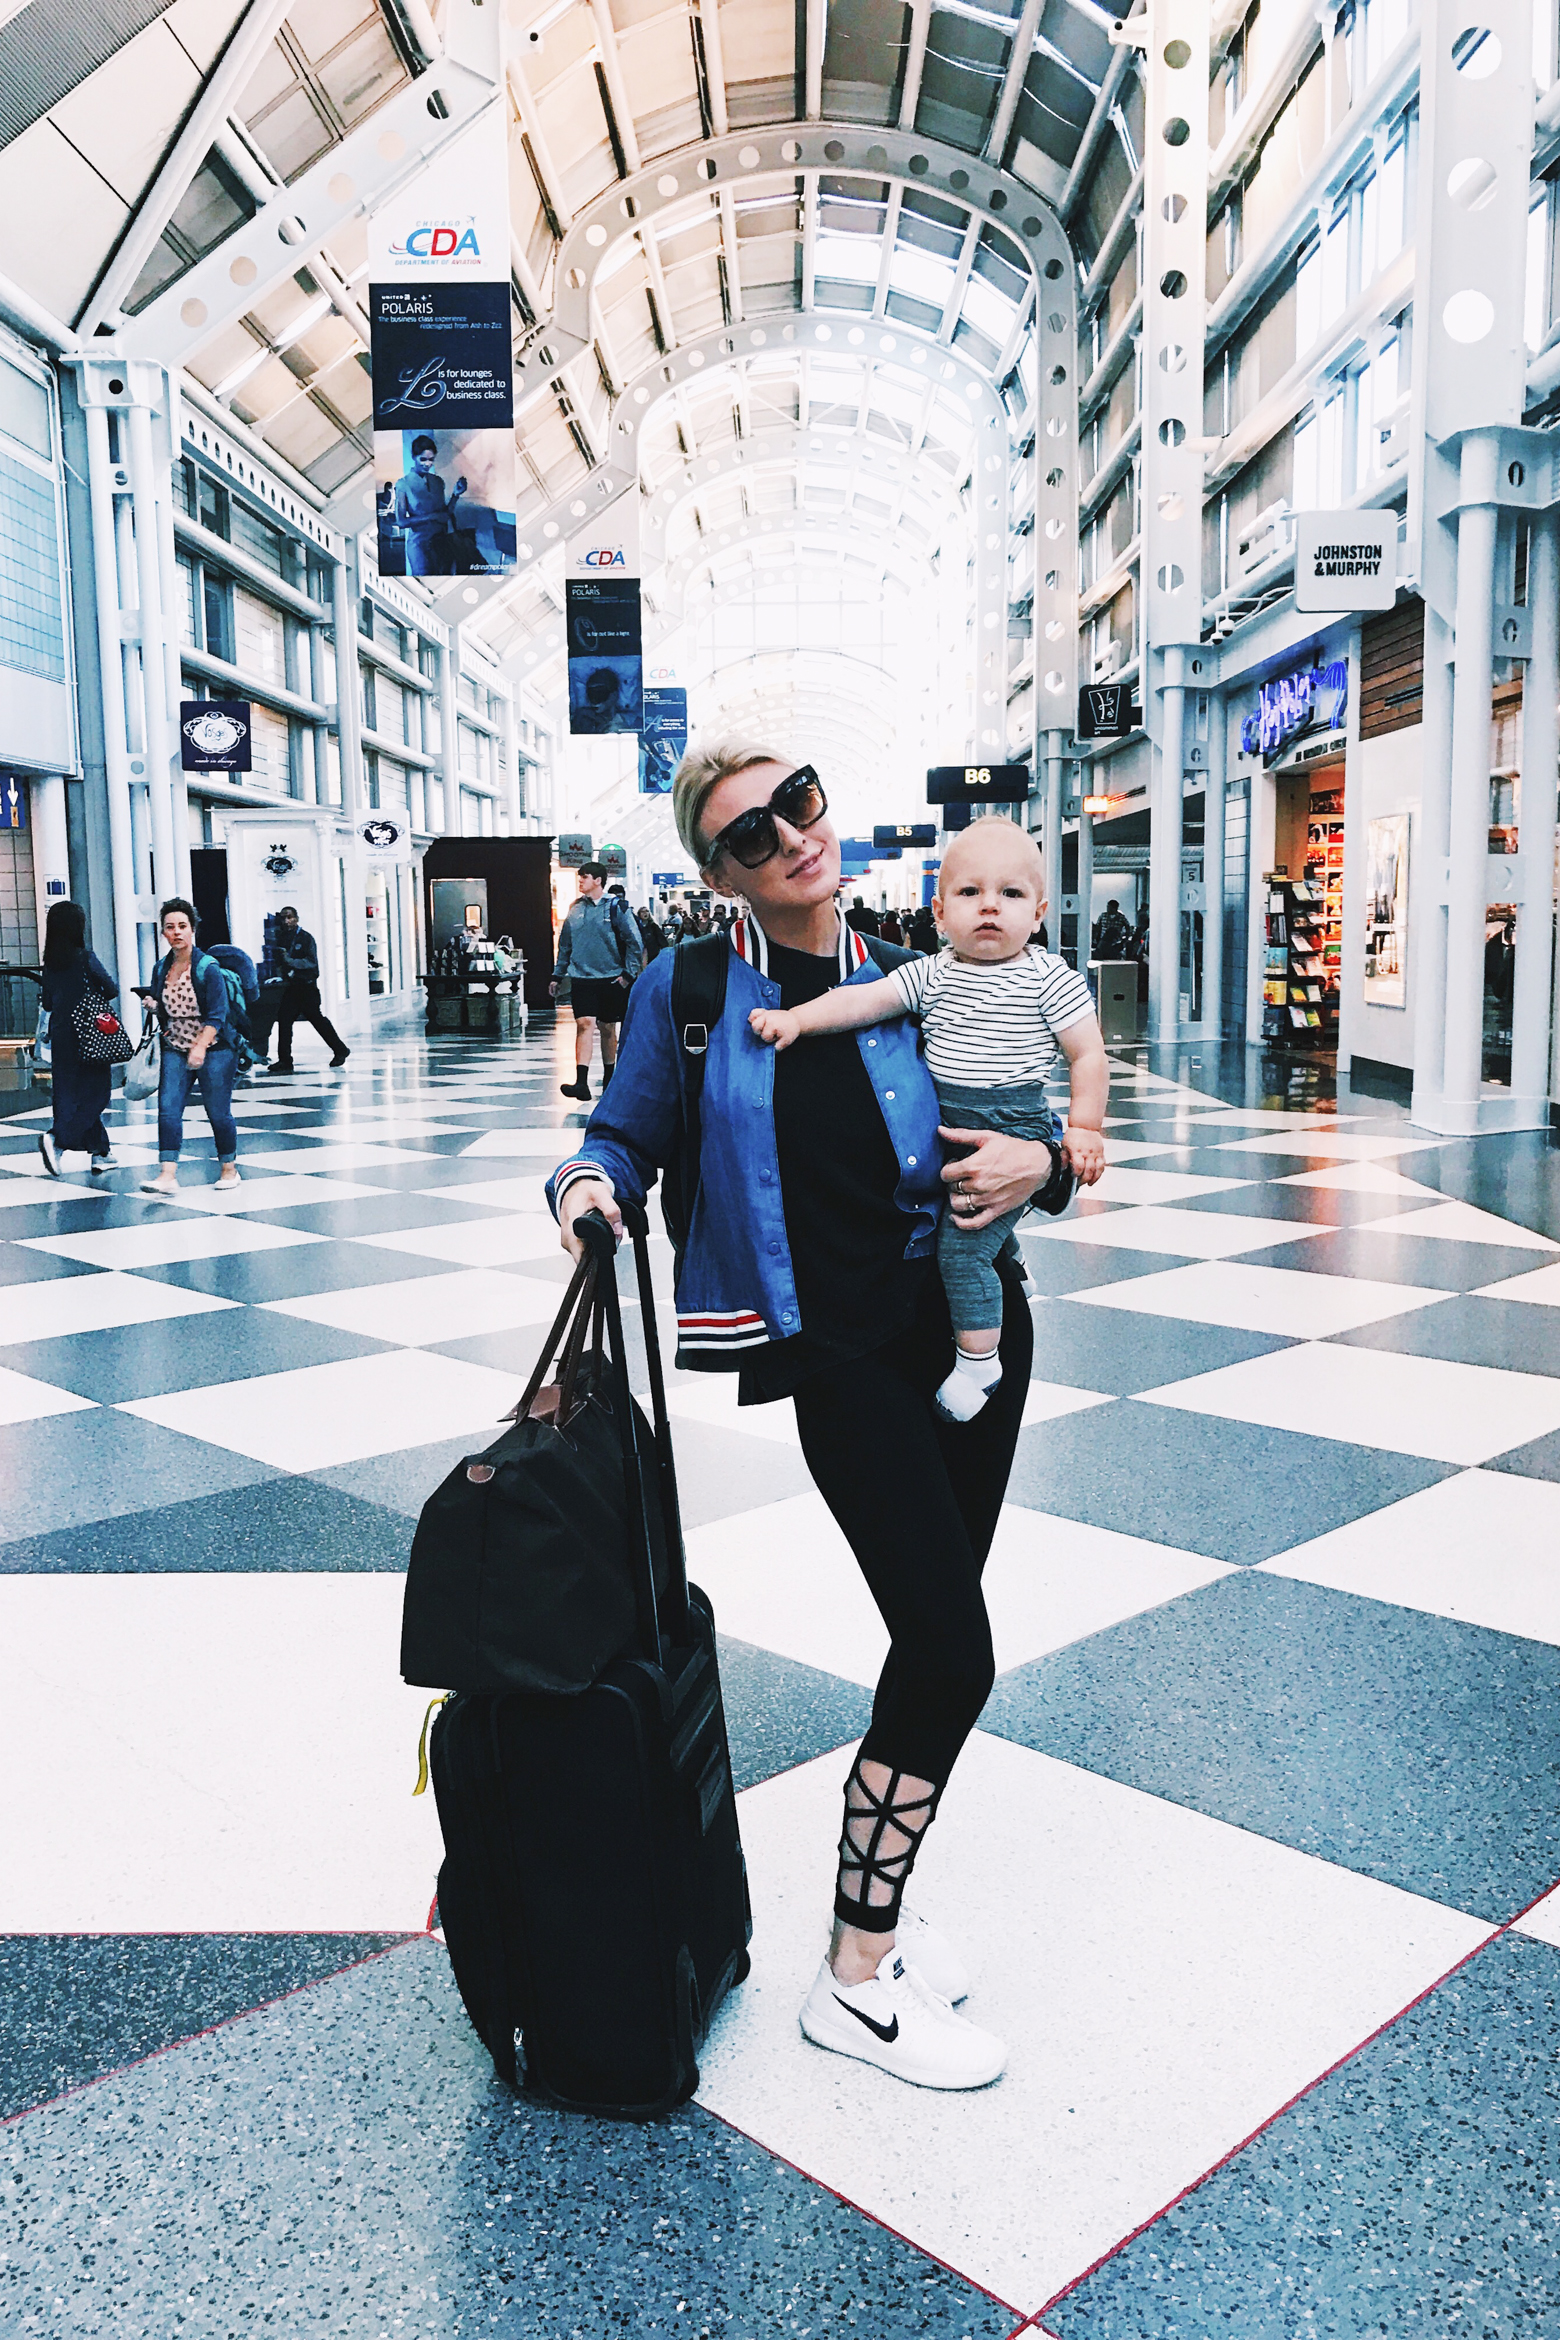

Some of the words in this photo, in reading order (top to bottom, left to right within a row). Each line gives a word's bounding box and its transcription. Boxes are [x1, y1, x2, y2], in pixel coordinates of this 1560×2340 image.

[405, 228, 480, 256] CDA
[381, 302, 434, 314] POLARIS
[438, 369, 445, 378] is
[447, 369, 458, 378] for
[460, 369, 492, 379] lounges
[454, 380, 494, 389] dedicated
[496, 380, 506, 388] to
[446, 391, 481, 399] business
[484, 391, 506, 399] class.
[585, 551, 625, 565] CDA
[1313, 545, 1382, 560] JOHNSTON
[649, 668, 676, 679] CDA
[200, 722, 228, 741] Vosges
[964, 768, 991, 785] B6
[896, 826, 913, 837] B5
[1188, 871, 1195, 881] 5
